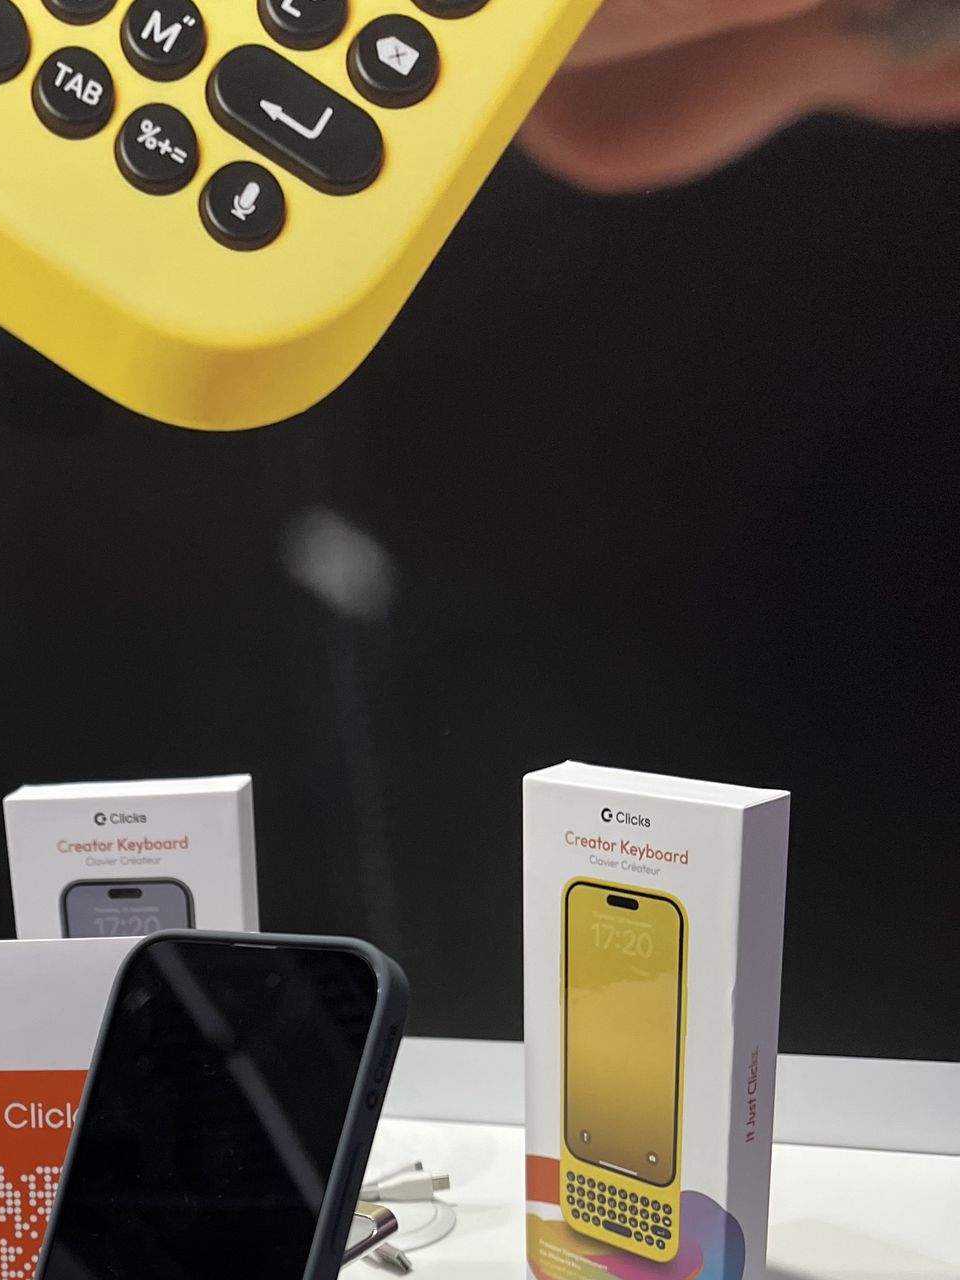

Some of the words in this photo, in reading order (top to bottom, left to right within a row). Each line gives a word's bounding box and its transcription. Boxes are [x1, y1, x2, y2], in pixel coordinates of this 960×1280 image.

[55, 61, 104, 105] TAB
[109, 812, 147, 825] Clicks
[615, 811, 651, 828] Clicks
[56, 839, 113, 853] Creator
[117, 835, 189, 854] Keyboard
[563, 830, 617, 853] Creator
[620, 839, 689, 865] Keyboard
[85, 857, 117, 867] Clavier
[589, 854, 619, 870] Clavier
[592, 923, 653, 959] 17:20
[4, 1102, 81, 1129] Click
[746, 1098, 756, 1127] Just
